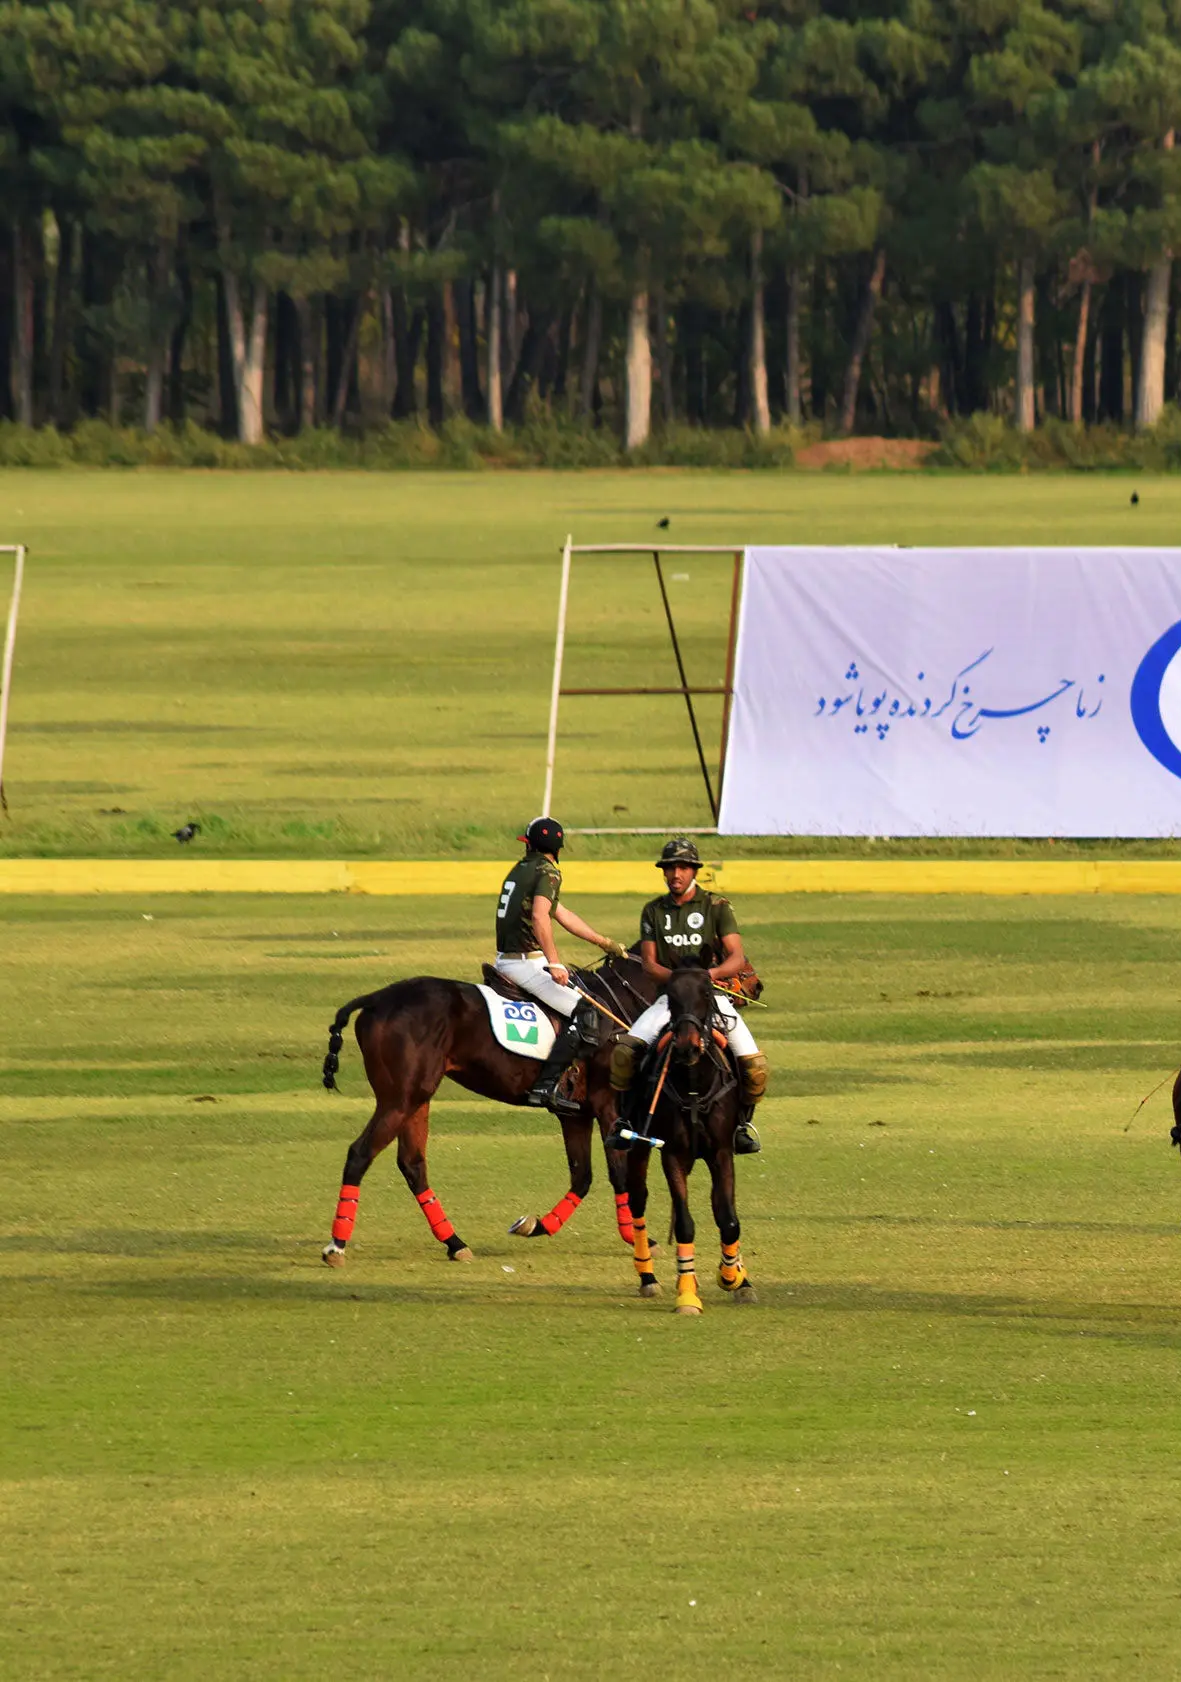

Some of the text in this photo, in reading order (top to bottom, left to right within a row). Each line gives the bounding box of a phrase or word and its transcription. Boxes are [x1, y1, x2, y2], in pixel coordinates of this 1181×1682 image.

[497, 880, 516, 918] 3
[664, 914, 672, 931] 1
[663, 933, 703, 947] POLO
